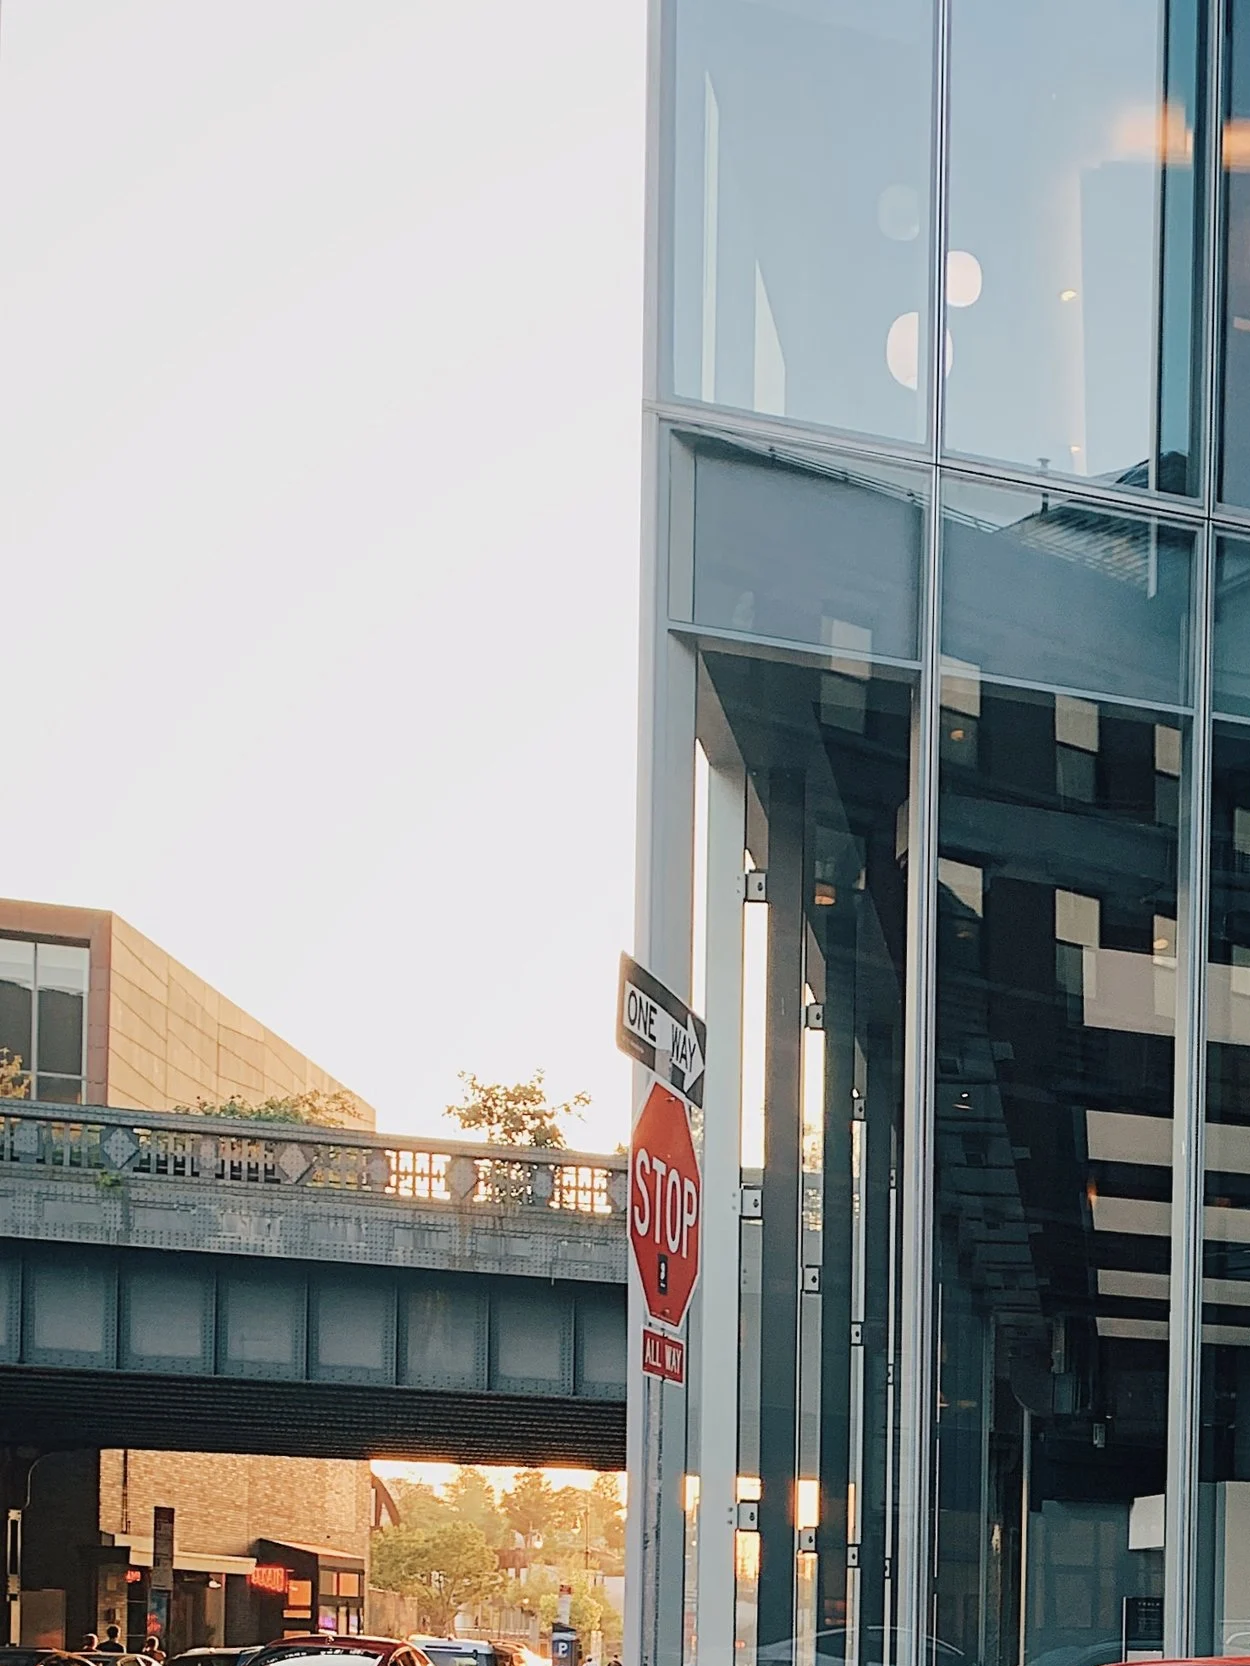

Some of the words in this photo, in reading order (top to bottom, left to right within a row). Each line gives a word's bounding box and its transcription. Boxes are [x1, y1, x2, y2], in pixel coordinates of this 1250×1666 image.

[627, 989, 657, 1043] ONE
[671, 1023, 696, 1073] WAY
[633, 1148, 698, 1259] STOP
[645, 1337, 662, 1368] ALL
[665, 1344, 682, 1375] WAY
[558, 1642, 568, 1658] P
